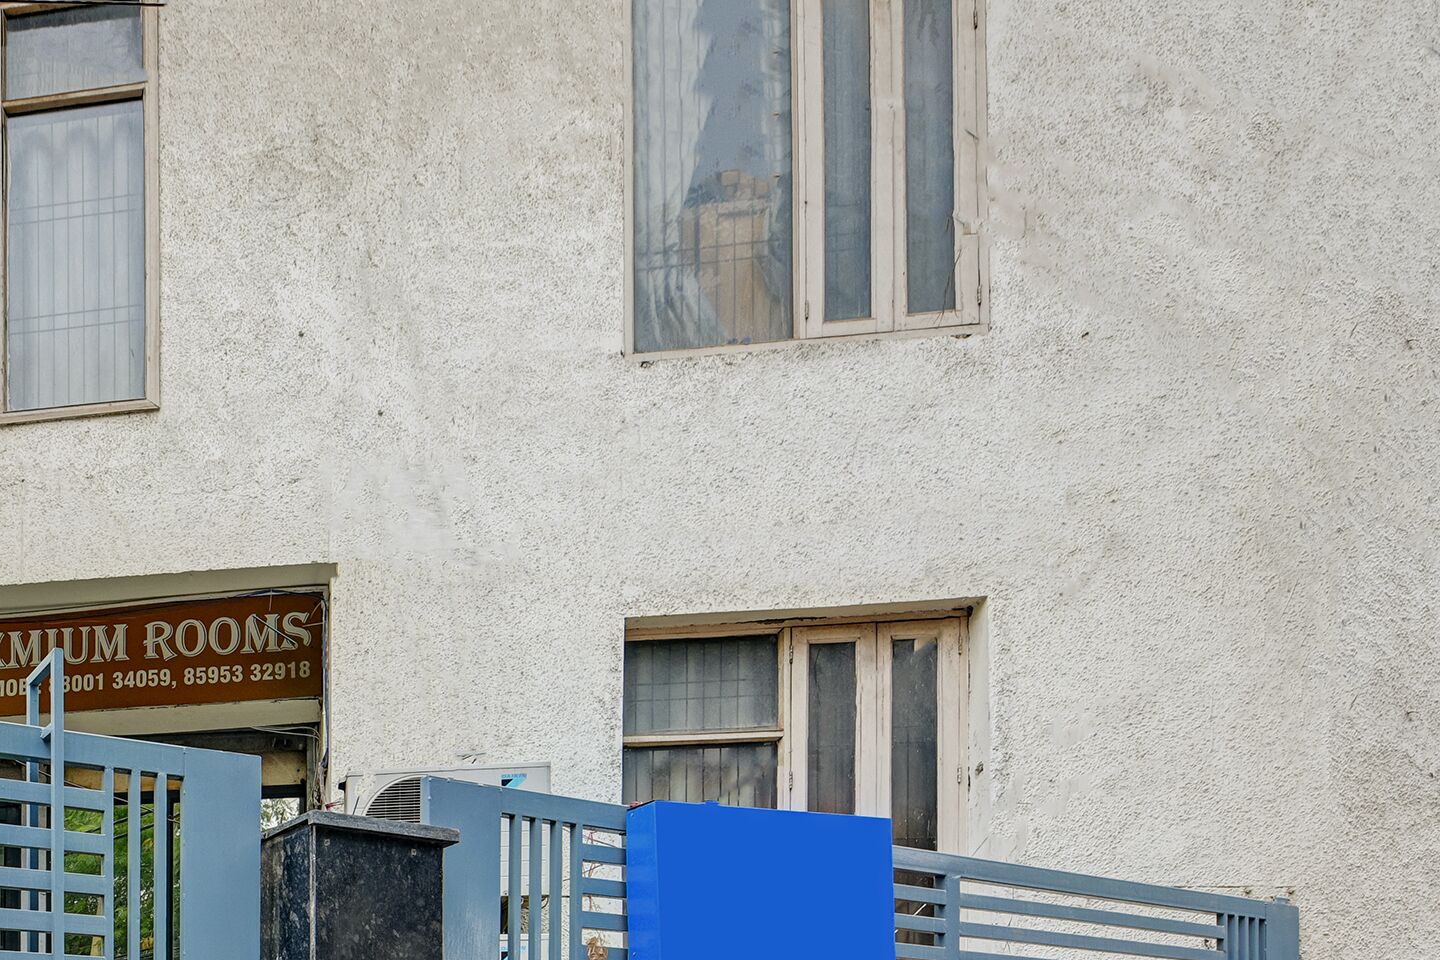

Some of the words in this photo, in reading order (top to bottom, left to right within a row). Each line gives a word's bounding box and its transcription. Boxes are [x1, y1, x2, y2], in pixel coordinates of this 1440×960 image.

[143, 611, 312, 662] ROOMS
[112, 668, 177, 689] 34059,
[183, 664, 244, 686] 85953
[250, 660, 311, 681] 32918
